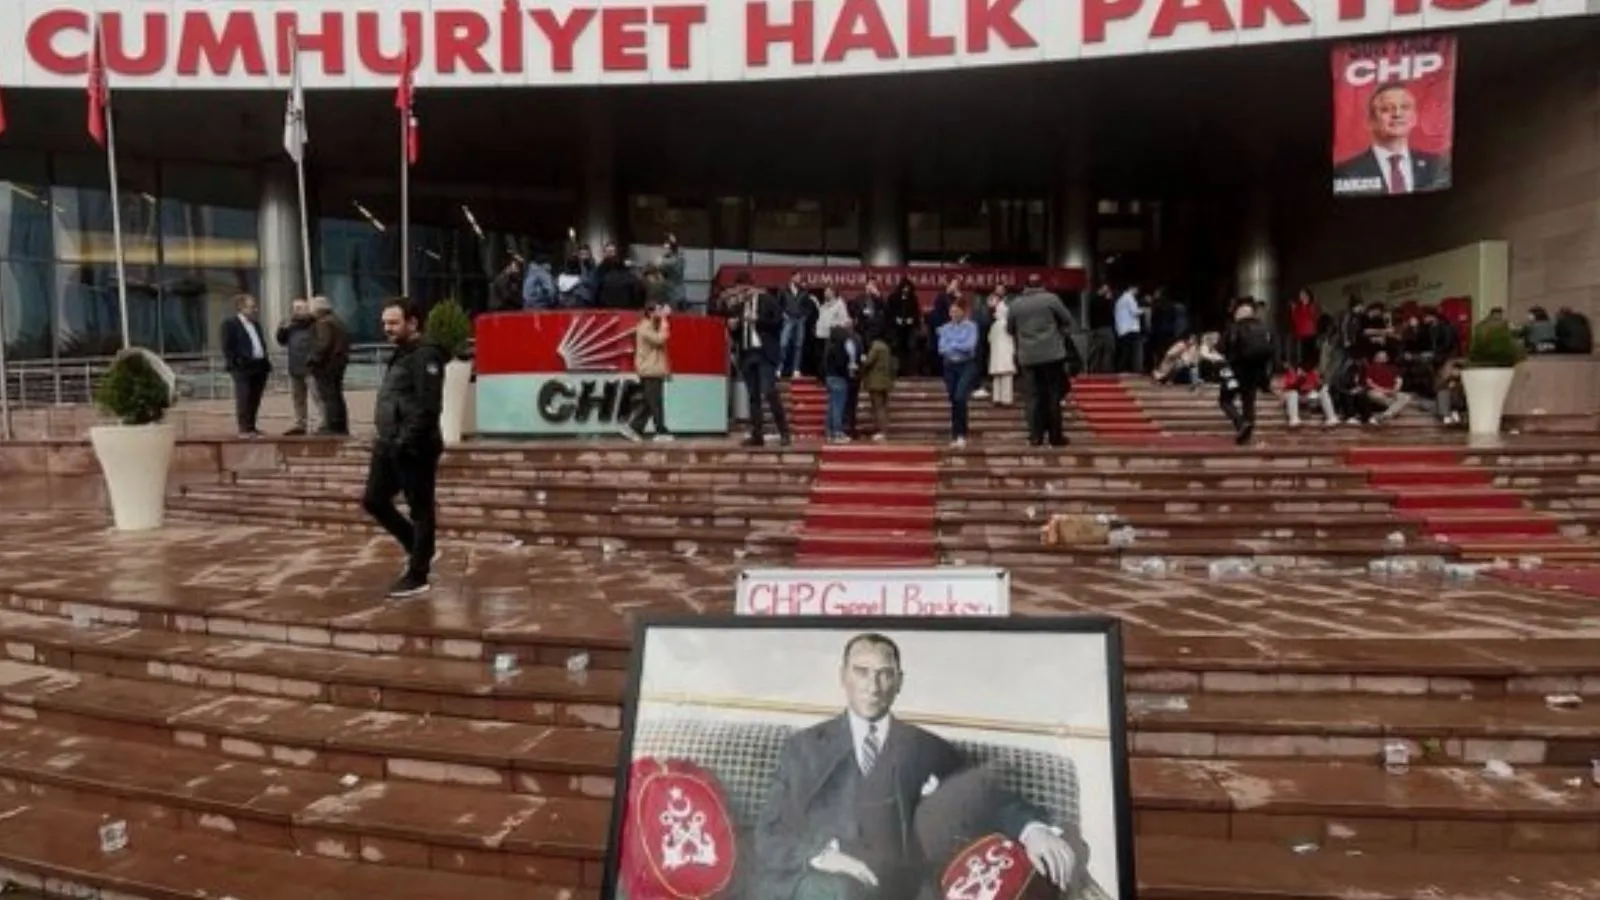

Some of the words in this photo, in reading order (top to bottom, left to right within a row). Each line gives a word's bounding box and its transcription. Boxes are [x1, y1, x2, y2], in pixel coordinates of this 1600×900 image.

[25, 0, 707, 76] CUMHURİYET
[746, 0, 1039, 67] HALK
[1346, 52, 1444, 86] CHP
[749, 583, 815, 615] CHP
